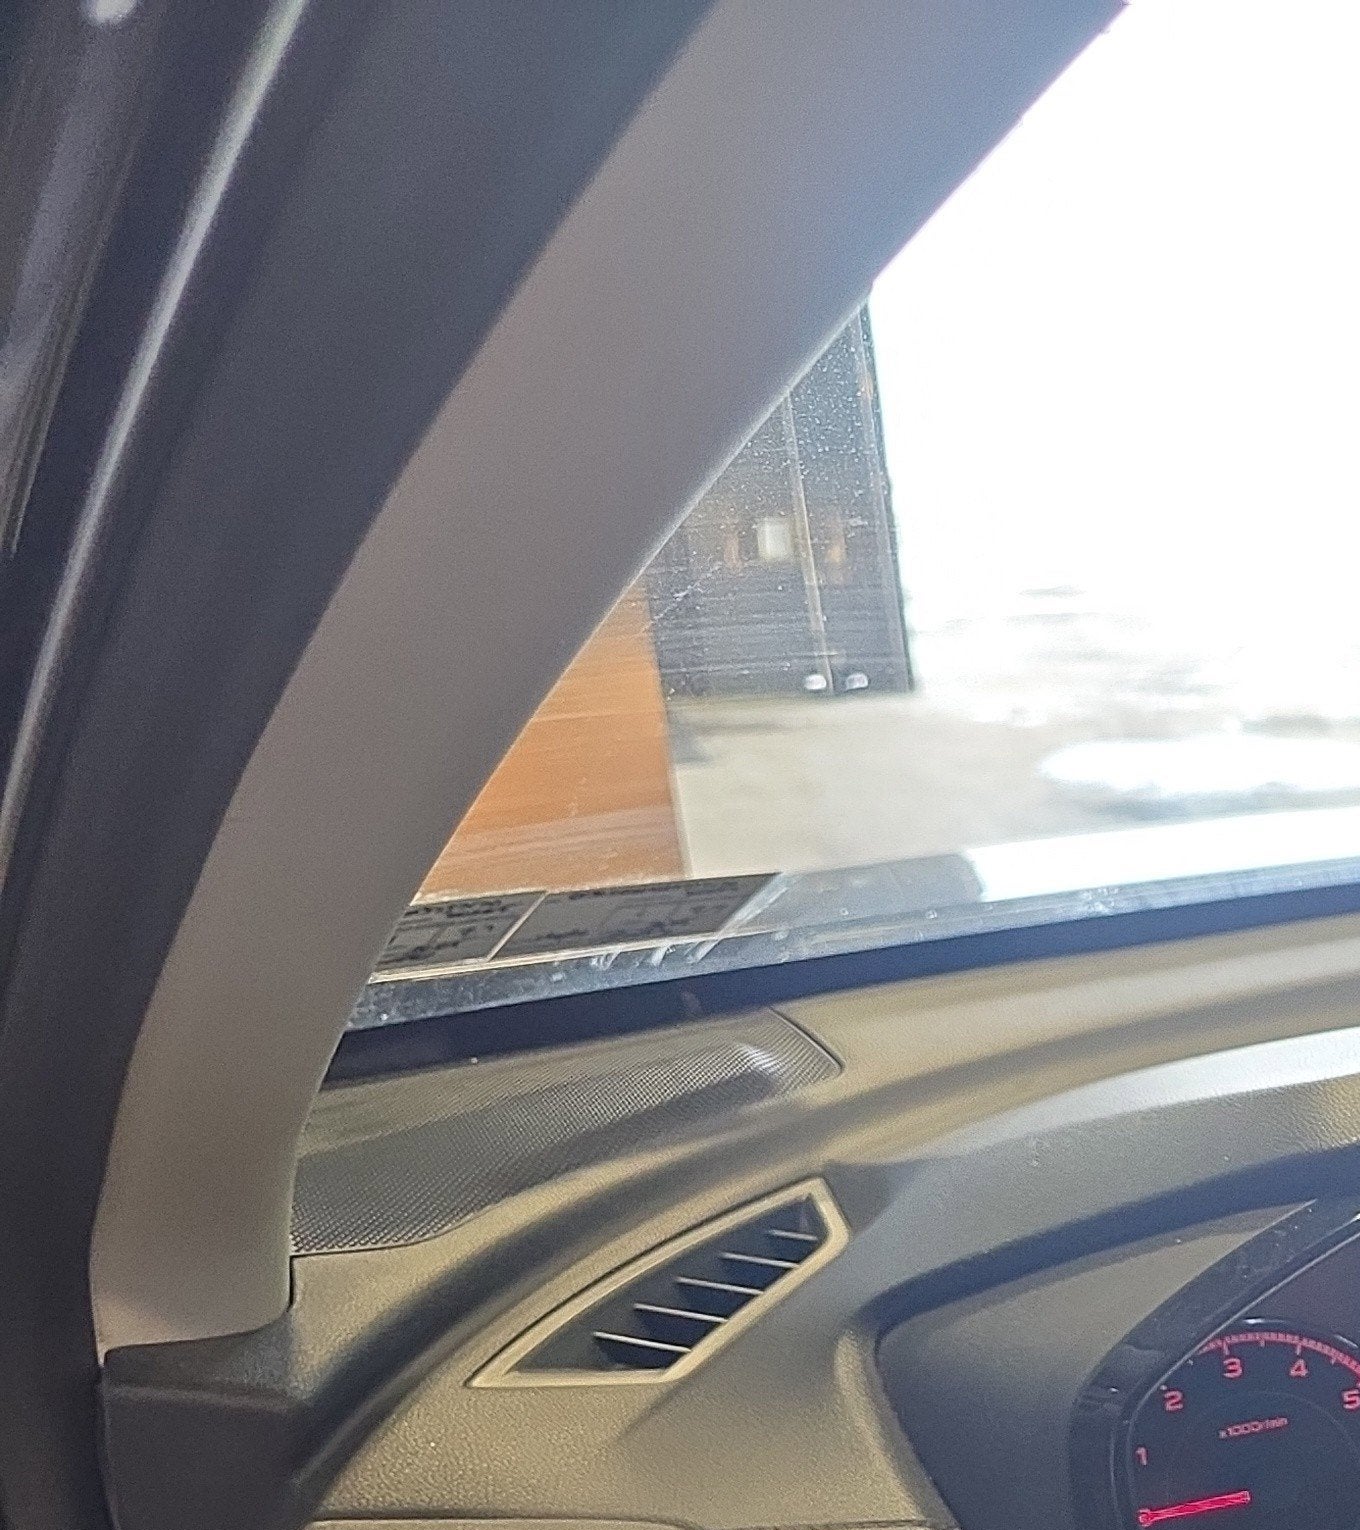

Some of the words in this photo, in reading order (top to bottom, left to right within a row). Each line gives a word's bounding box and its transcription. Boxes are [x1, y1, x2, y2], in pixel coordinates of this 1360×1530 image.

[1223, 1357, 1243, 1379] 3
[1289, 1358, 1309, 1378] 4
[1164, 1390, 1184, 1412] 2
[1135, 1446, 1148, 1466] 1
